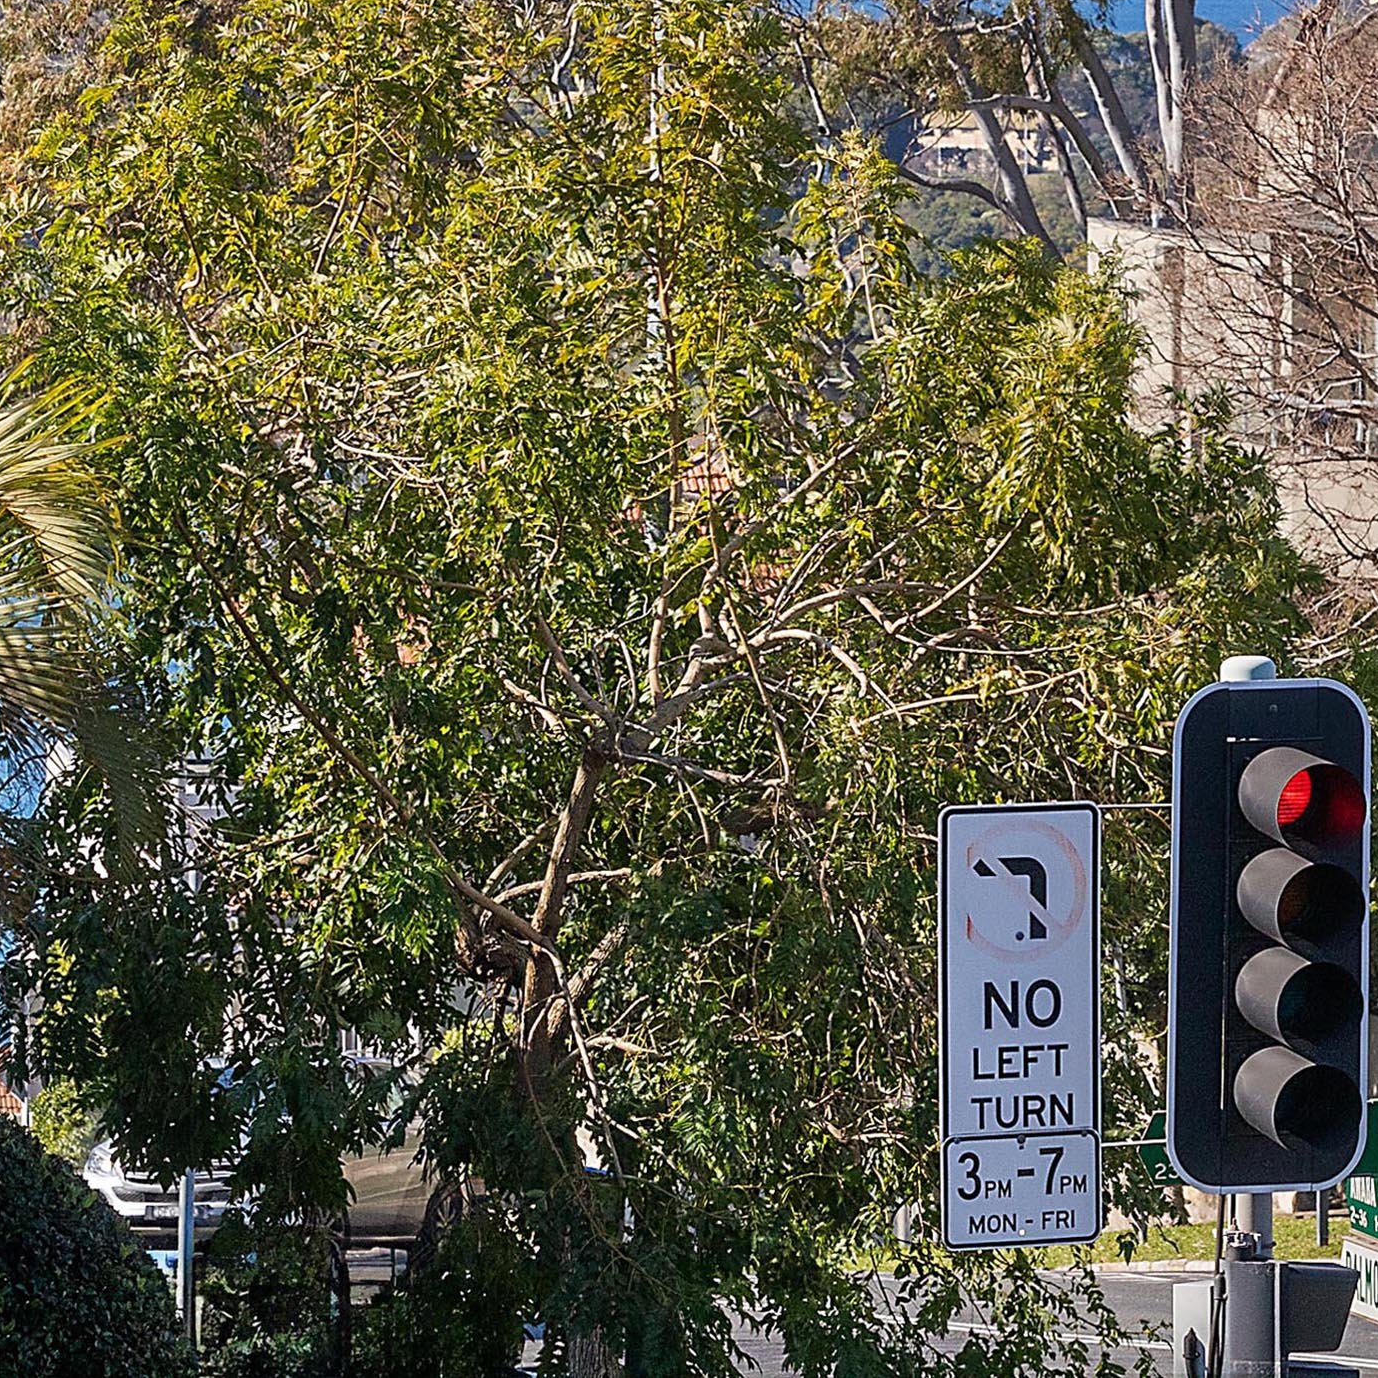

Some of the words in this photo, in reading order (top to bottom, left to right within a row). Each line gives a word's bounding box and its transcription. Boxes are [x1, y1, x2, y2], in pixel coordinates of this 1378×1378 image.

[983, 978, 1062, 1030] NO
[972, 1043, 1070, 1081] LEFT
[970, 1092, 1074, 1131] TURN
[968, 1212, 1017, 1235] MON
[1042, 1209, 1075, 1230] FRI
